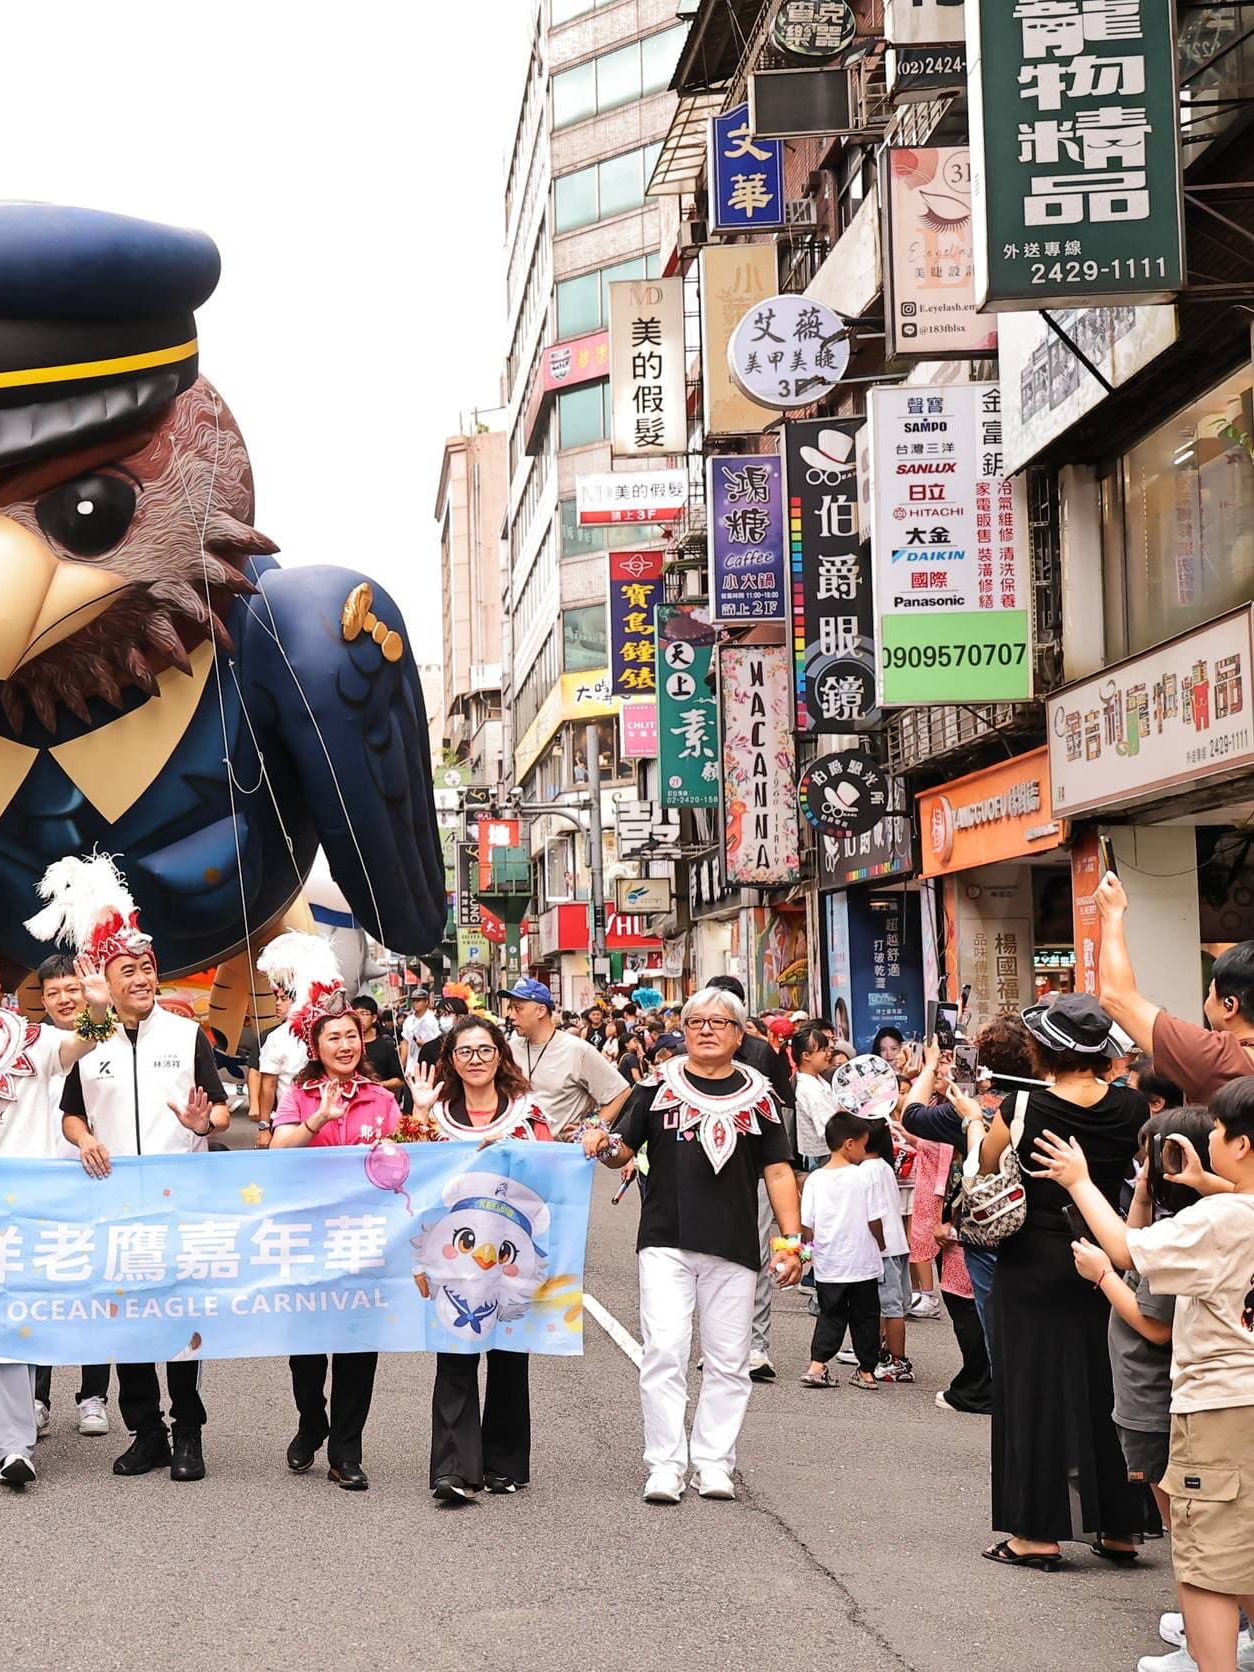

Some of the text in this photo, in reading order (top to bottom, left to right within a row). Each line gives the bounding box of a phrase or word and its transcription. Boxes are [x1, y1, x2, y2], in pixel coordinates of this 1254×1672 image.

[724, 122, 774, 218] 文華
[1003, 240, 1082, 260] 外送專線
[1030, 257, 1167, 285] 2429-1111
[750, 307, 827, 343] 艾薇
[744, 349, 838, 375] 美甲美睫
[631, 316, 664, 448] 美的假髮
[907, 396, 944, 414] 聲寶
[904, 418, 948, 433] SAMPO
[895, 443, 955, 455] 台灣三洋
[896, 463, 957, 475] SANLUX
[614, 482, 683, 500] 美的假髮
[909, 483, 946, 501] 日立
[909, 507, 964, 518] HITACHI
[976, 482, 992, 543] 家電販售
[997, 481, 1014, 543] 冷氣維修
[905, 526, 951, 545] 大金
[906, 550, 965, 562] DAIKIN
[722, 572, 776, 590] 小火鍋
[911, 571, 948, 588] 國際
[999, 547, 1016, 609] 清洗保養
[814, 493, 867, 720] 伯爵眼鏡
[894, 594, 965, 608] Panasonic
[882, 642, 1027, 669] 0909570707
[7, 1299, 112, 1322] OCEAN
[124, 1295, 221, 1319] EAGLE
[230, 1287, 389, 1316] CARNIVAL
